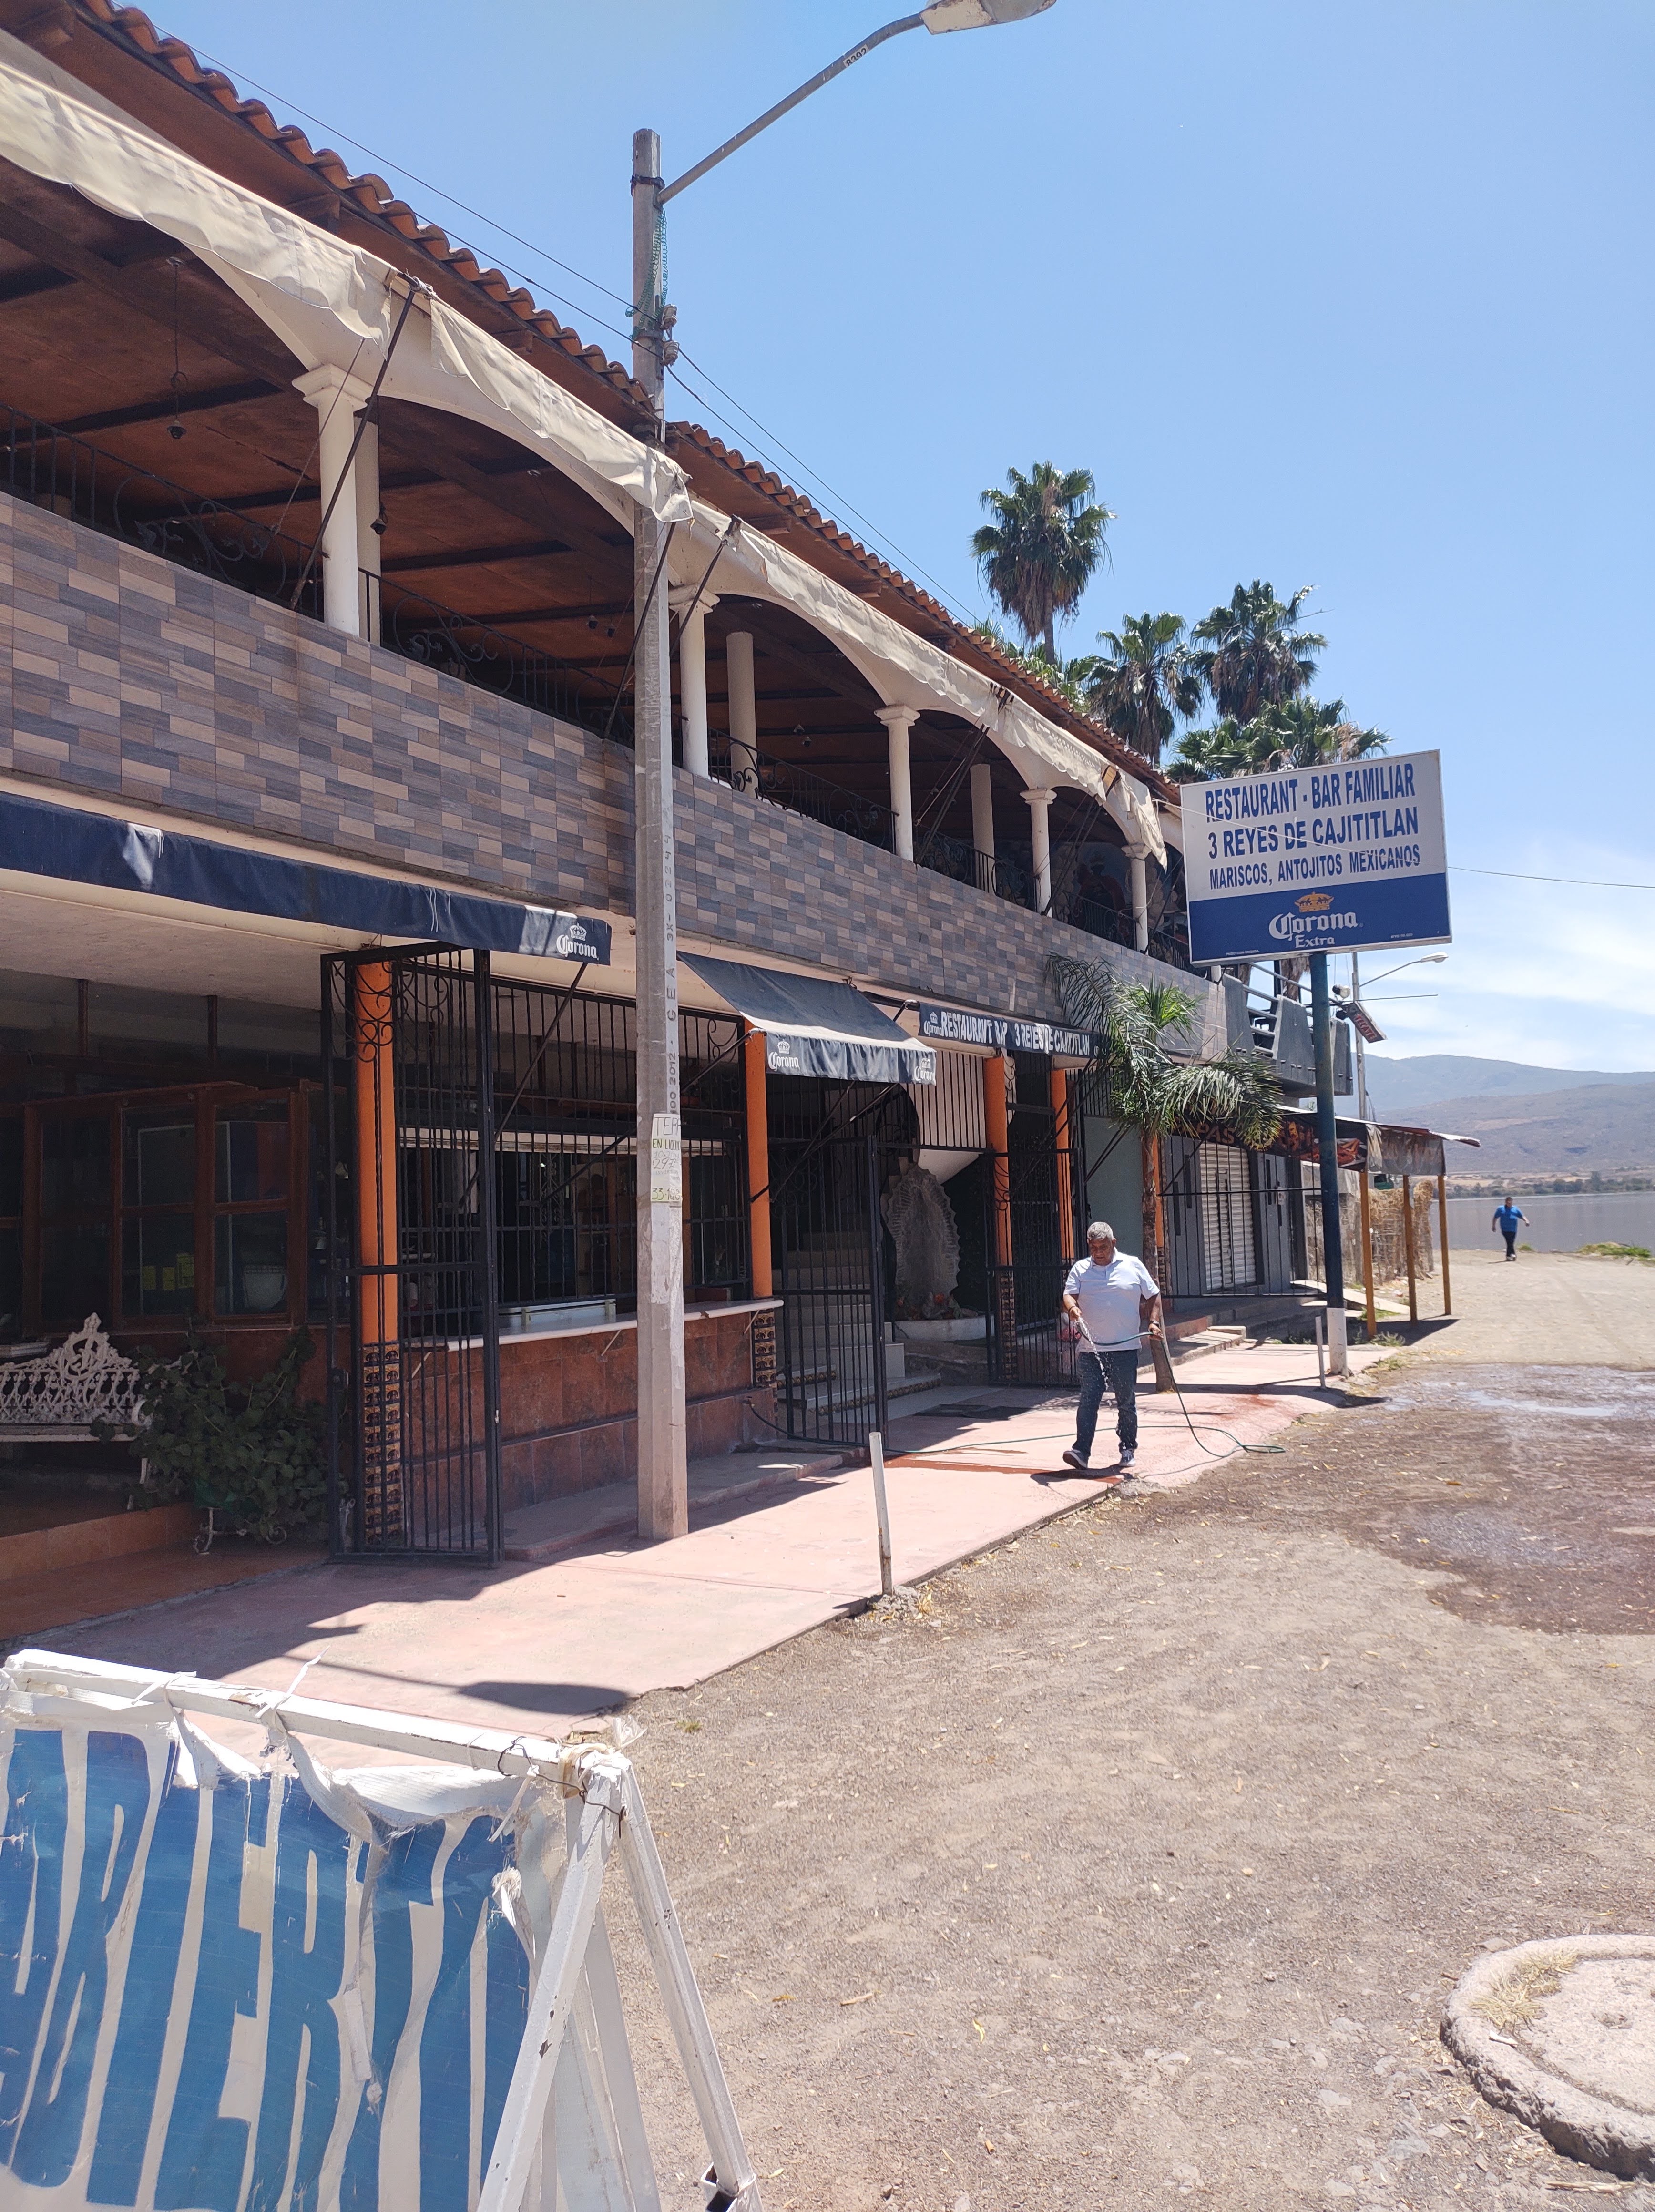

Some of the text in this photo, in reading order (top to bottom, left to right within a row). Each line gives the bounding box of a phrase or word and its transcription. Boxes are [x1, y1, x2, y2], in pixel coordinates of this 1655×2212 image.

[1205, 778, 1298, 823] RESTAURANT
[1311, 773, 1342, 809] BAR
[1345, 763, 1416, 805] FAMILIAR
[1208, 806, 1419, 860] 3 REYES DE CAJITITLAN
[1209, 844, 1421, 890] MARISCOS, ANTOJITOS MEXICANOS
[1268, 911, 1359, 941] Corona
[556, 934, 598, 958] Corona
[1295, 934, 1335, 948] Extra
[924, 1020, 942, 1037] Corona
[941, 1011, 992, 1044] RESTAURANT
[1014, 1023, 1021, 1047] 3
[1021, 1024, 1044, 1050] REYES
[768, 1052, 800, 1072] Corona
[653, 1138, 662, 1149] EN
